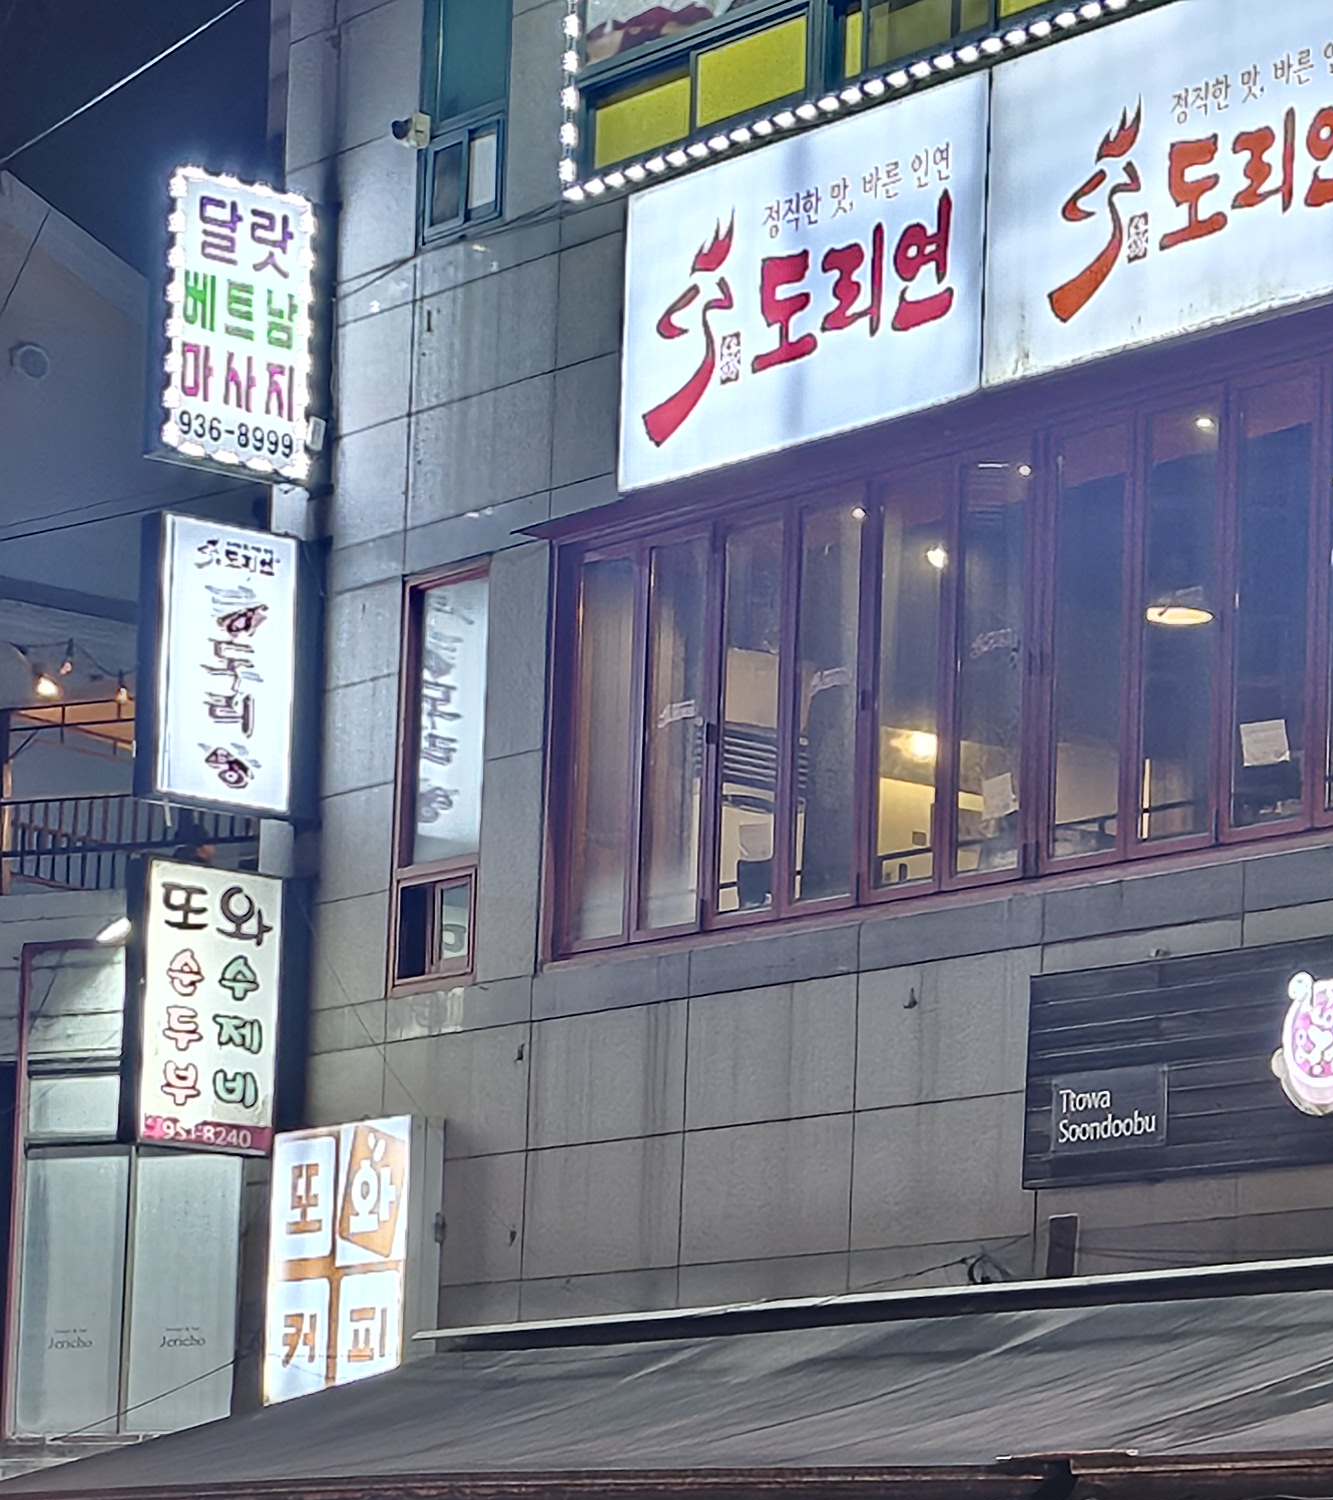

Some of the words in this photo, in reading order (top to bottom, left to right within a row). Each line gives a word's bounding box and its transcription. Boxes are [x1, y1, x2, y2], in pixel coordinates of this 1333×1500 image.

[1170, 74, 1231, 125] 정직한
[1272, 48, 1315, 85] 바른
[762, 186, 822, 239] 정직한
[861, 160, 903, 200] 바른
[910, 141, 951, 189] 인연
[198, 195, 295, 279] 달랏
[182, 268, 299, 350] 베트남
[751, 187, 955, 375] 도리연
[180, 340, 296, 422] 마사지
[178, 410, 295, 459] 936-8999
[161, 880, 274, 947] 또와
[161, 947, 205, 1107] 순두부
[211, 954, 263, 1109] 수제비
[1058, 1109, 1156, 1143] Soondoobu
[1059, 1089, 1111, 1113] Ttowa
[285, 1157, 397, 1236] 또와
[281, 1306, 388, 1369] 커피
